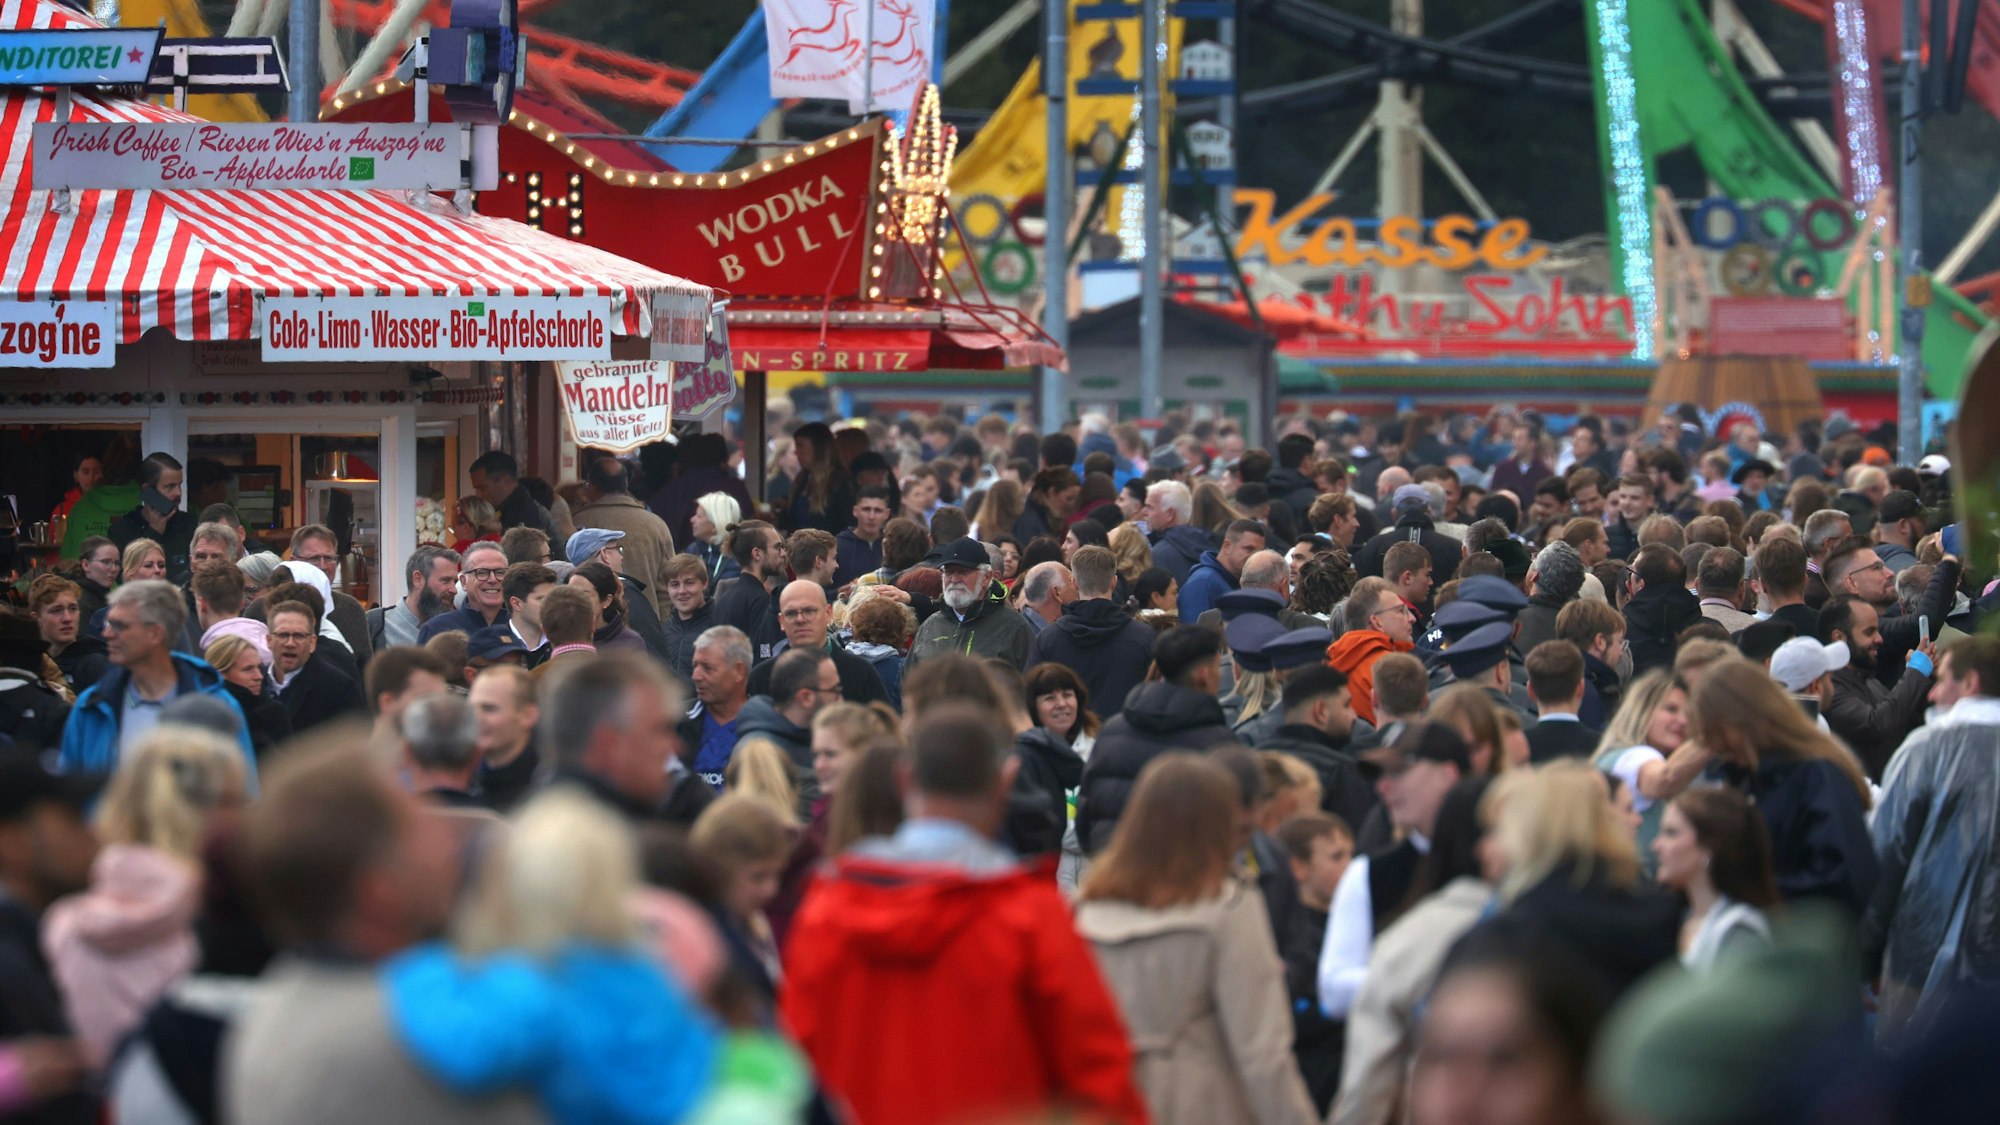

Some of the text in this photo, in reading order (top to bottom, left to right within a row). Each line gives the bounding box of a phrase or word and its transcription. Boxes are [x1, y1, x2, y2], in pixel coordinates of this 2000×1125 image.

[0, 46, 122, 71] NDITOREI
[50, 124, 111, 160] Irish
[113, 125, 181, 161] Coffee
[198, 125, 270, 153] Riesen
[273, 126, 342, 153] Wies'n
[696, 175, 846, 248] WODKA
[1232, 188, 1548, 269] Kasse
[718, 213, 853, 283] BULL
[1464, 275, 1637, 335] Sohn
[269, 309, 309, 349] Cola
[318, 310, 361, 349] Limo
[371, 309, 441, 349] Wasser
[450, 309, 604, 355] Bio-Apfelschorle
[573, 360, 659, 381] gebrannte
[564, 375, 669, 414] Mandeln
[594, 412, 647, 426] Nüsse
[603, 427, 629, 441] aller
